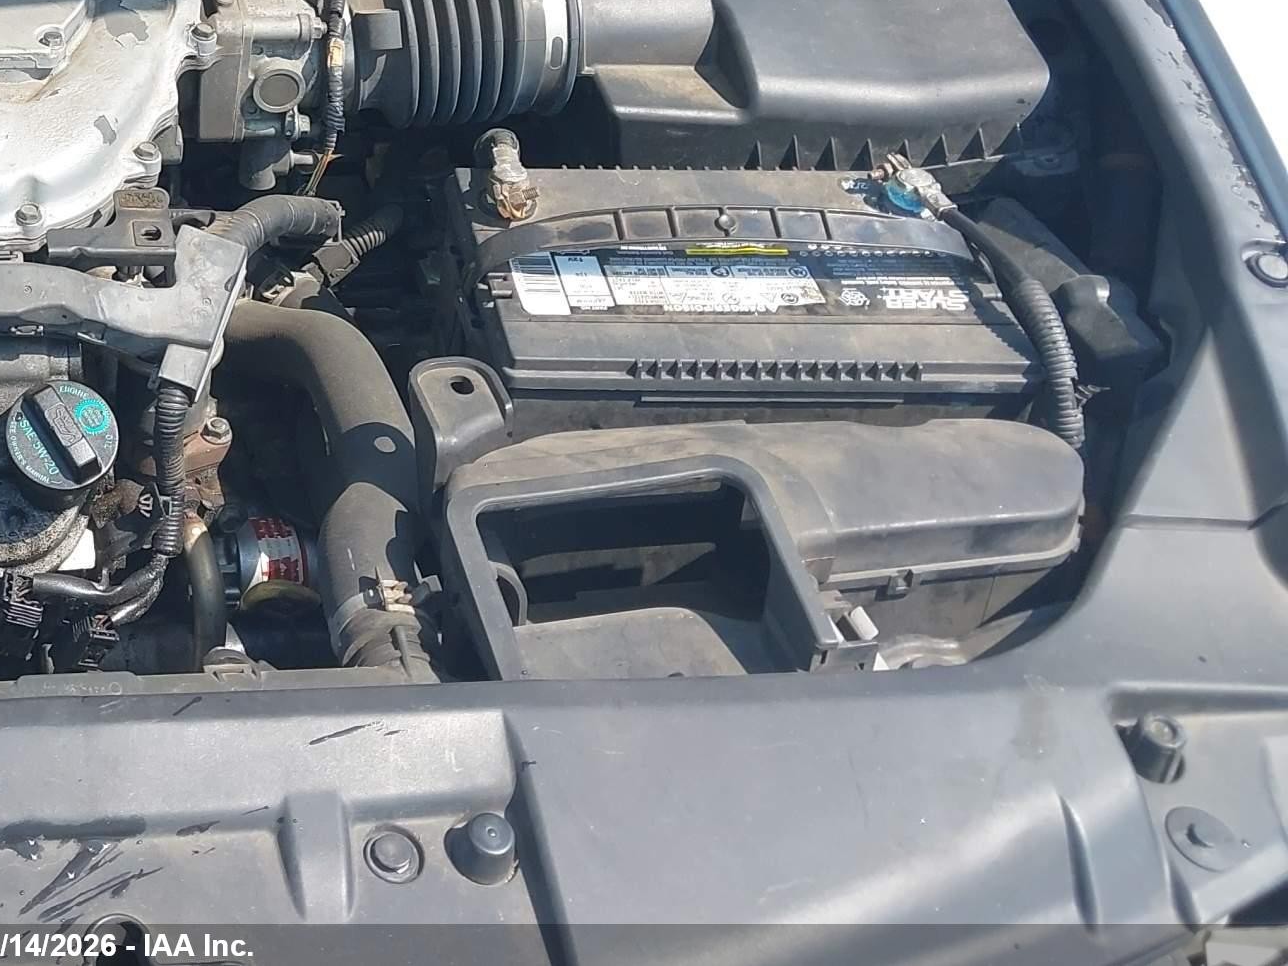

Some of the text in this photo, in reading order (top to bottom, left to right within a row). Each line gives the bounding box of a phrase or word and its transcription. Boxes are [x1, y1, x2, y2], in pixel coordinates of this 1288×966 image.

[887, 289, 969, 300] START
[885, 299, 968, 311] SUPER
[58, 385, 90, 400] ENGINE
[18, 418, 60, 475] SAE 5W-20
[103, 434, 114, 449] OIL
